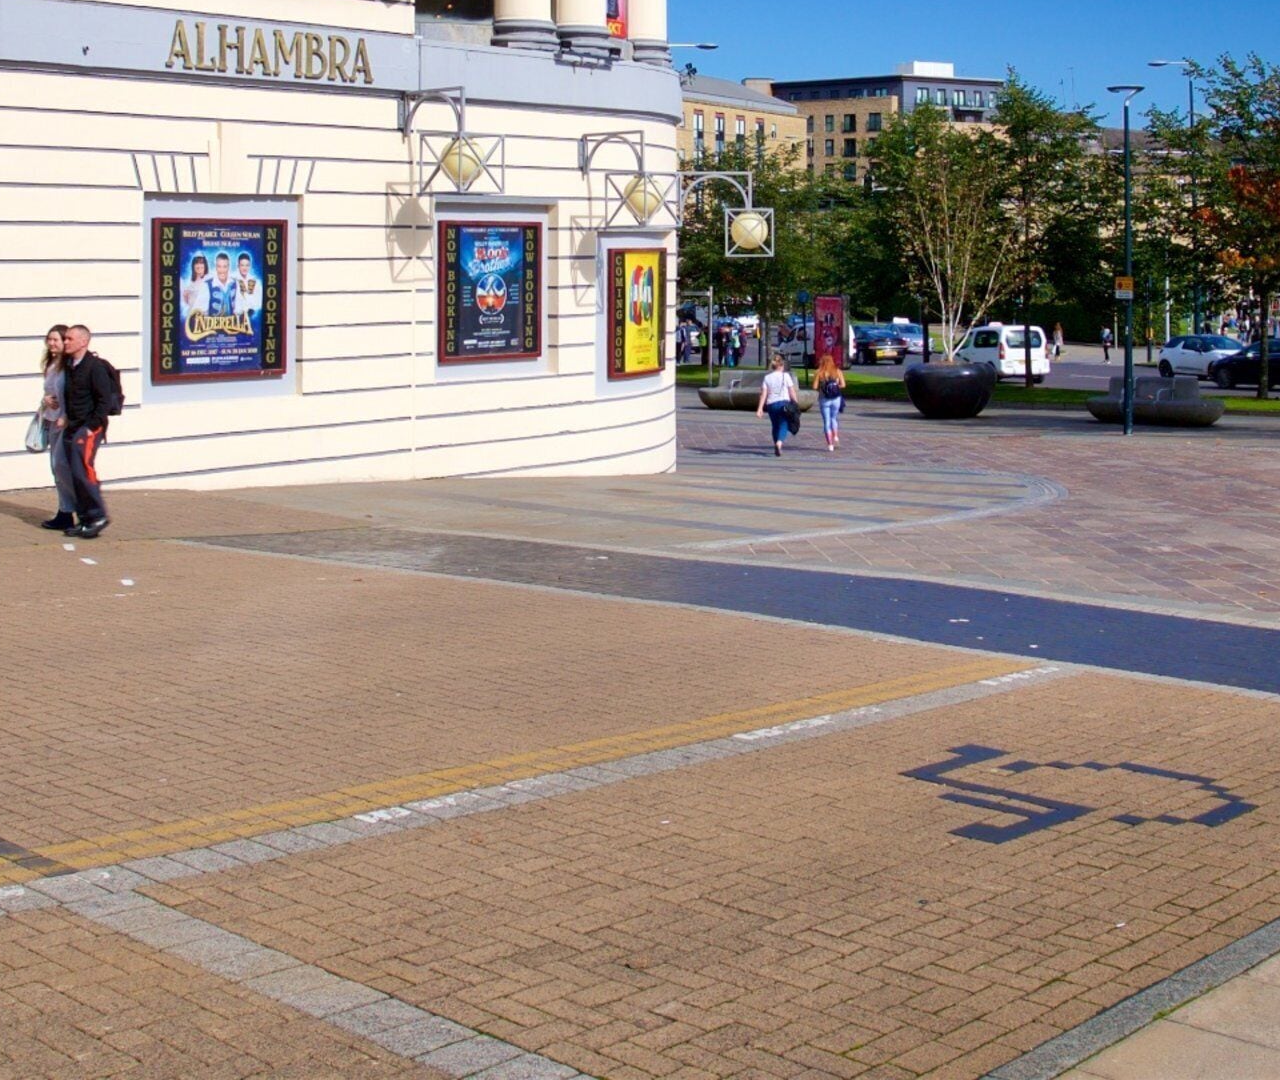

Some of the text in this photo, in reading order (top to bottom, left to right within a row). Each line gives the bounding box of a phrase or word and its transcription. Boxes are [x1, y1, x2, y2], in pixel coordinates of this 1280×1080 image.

[165, 19, 375, 84] ALHAMBRA
[162, 227, 174, 369] NOW BOOKING
[185, 307, 254, 342] CINDERELLA
[266, 228, 278, 363] NOW BOOKING
[446, 229, 456, 352] NOW BOOKING
[524, 229, 535, 348] NOW BOOKING
[615, 256, 624, 368] COMING SOON
